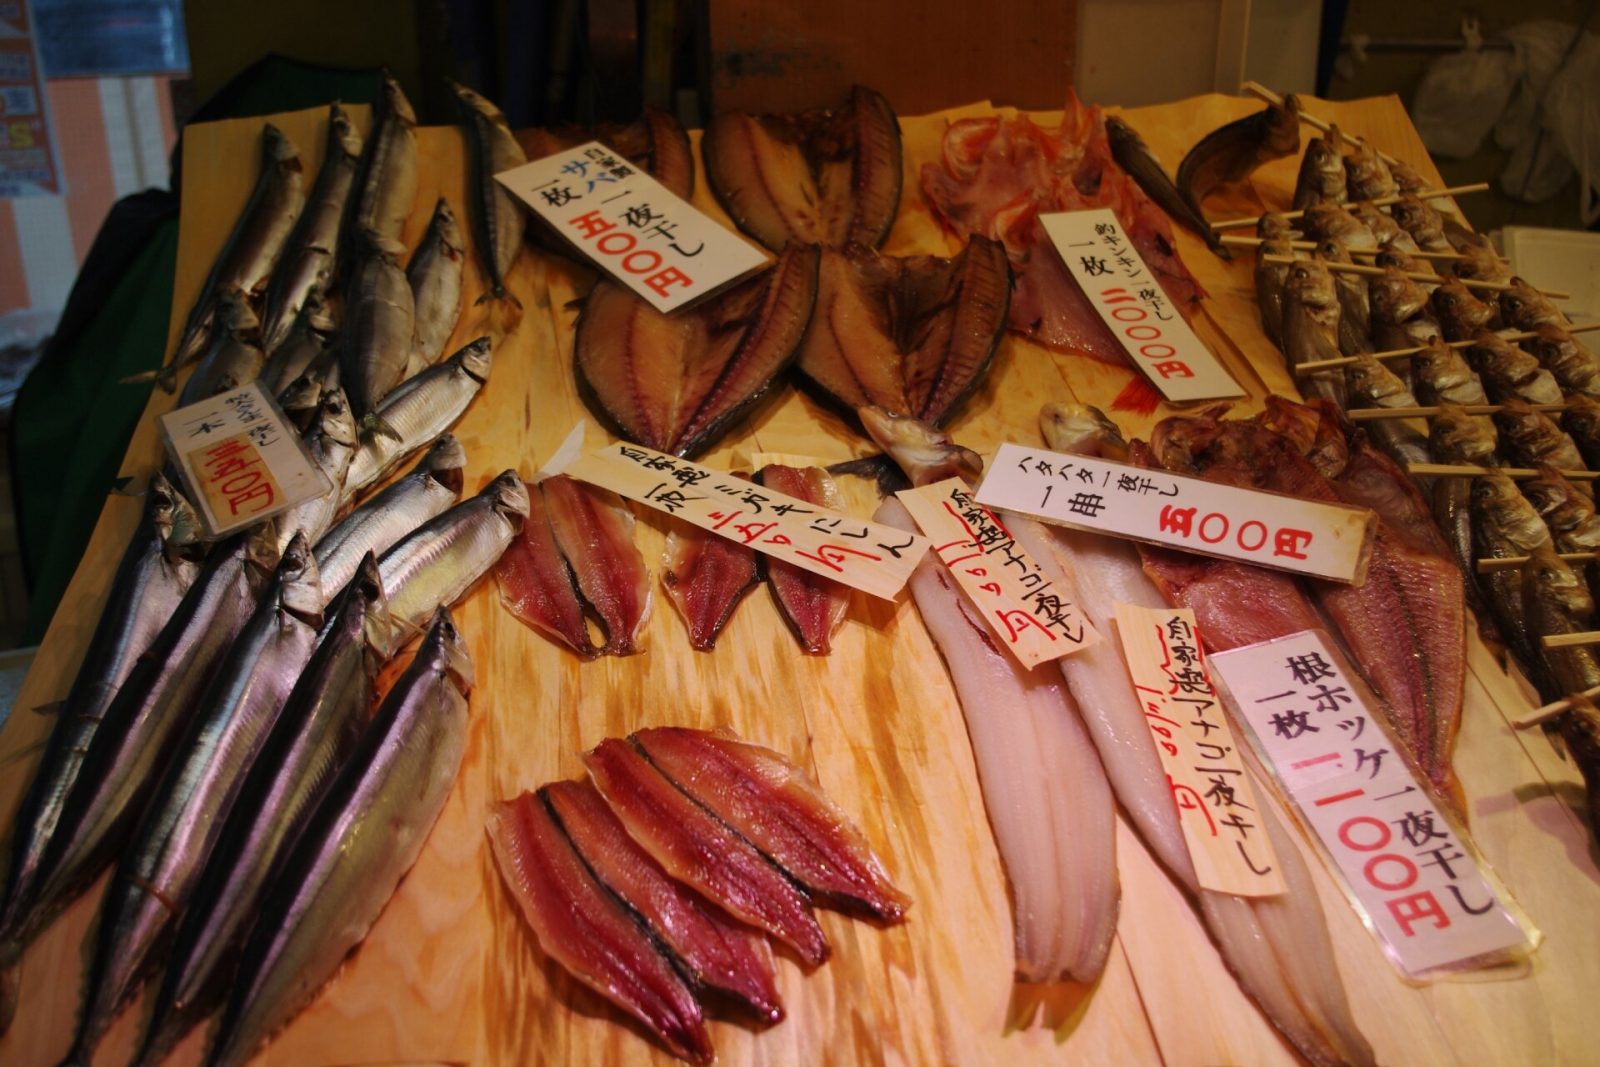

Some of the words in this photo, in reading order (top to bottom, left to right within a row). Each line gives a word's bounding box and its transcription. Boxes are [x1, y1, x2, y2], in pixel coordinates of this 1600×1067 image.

[531, 179, 583, 207] 一枚
[1069, 241, 1114, 276] 一枚
[1017, 456, 1180, 497] ハタハタ一夜干し
[645, 482, 709, 513] 一枚
[1040, 485, 1106, 519] 一串
[1254, 689, 1320, 740] 一枚
[1286, 652, 1494, 916] 根ホッケ一夜干し
